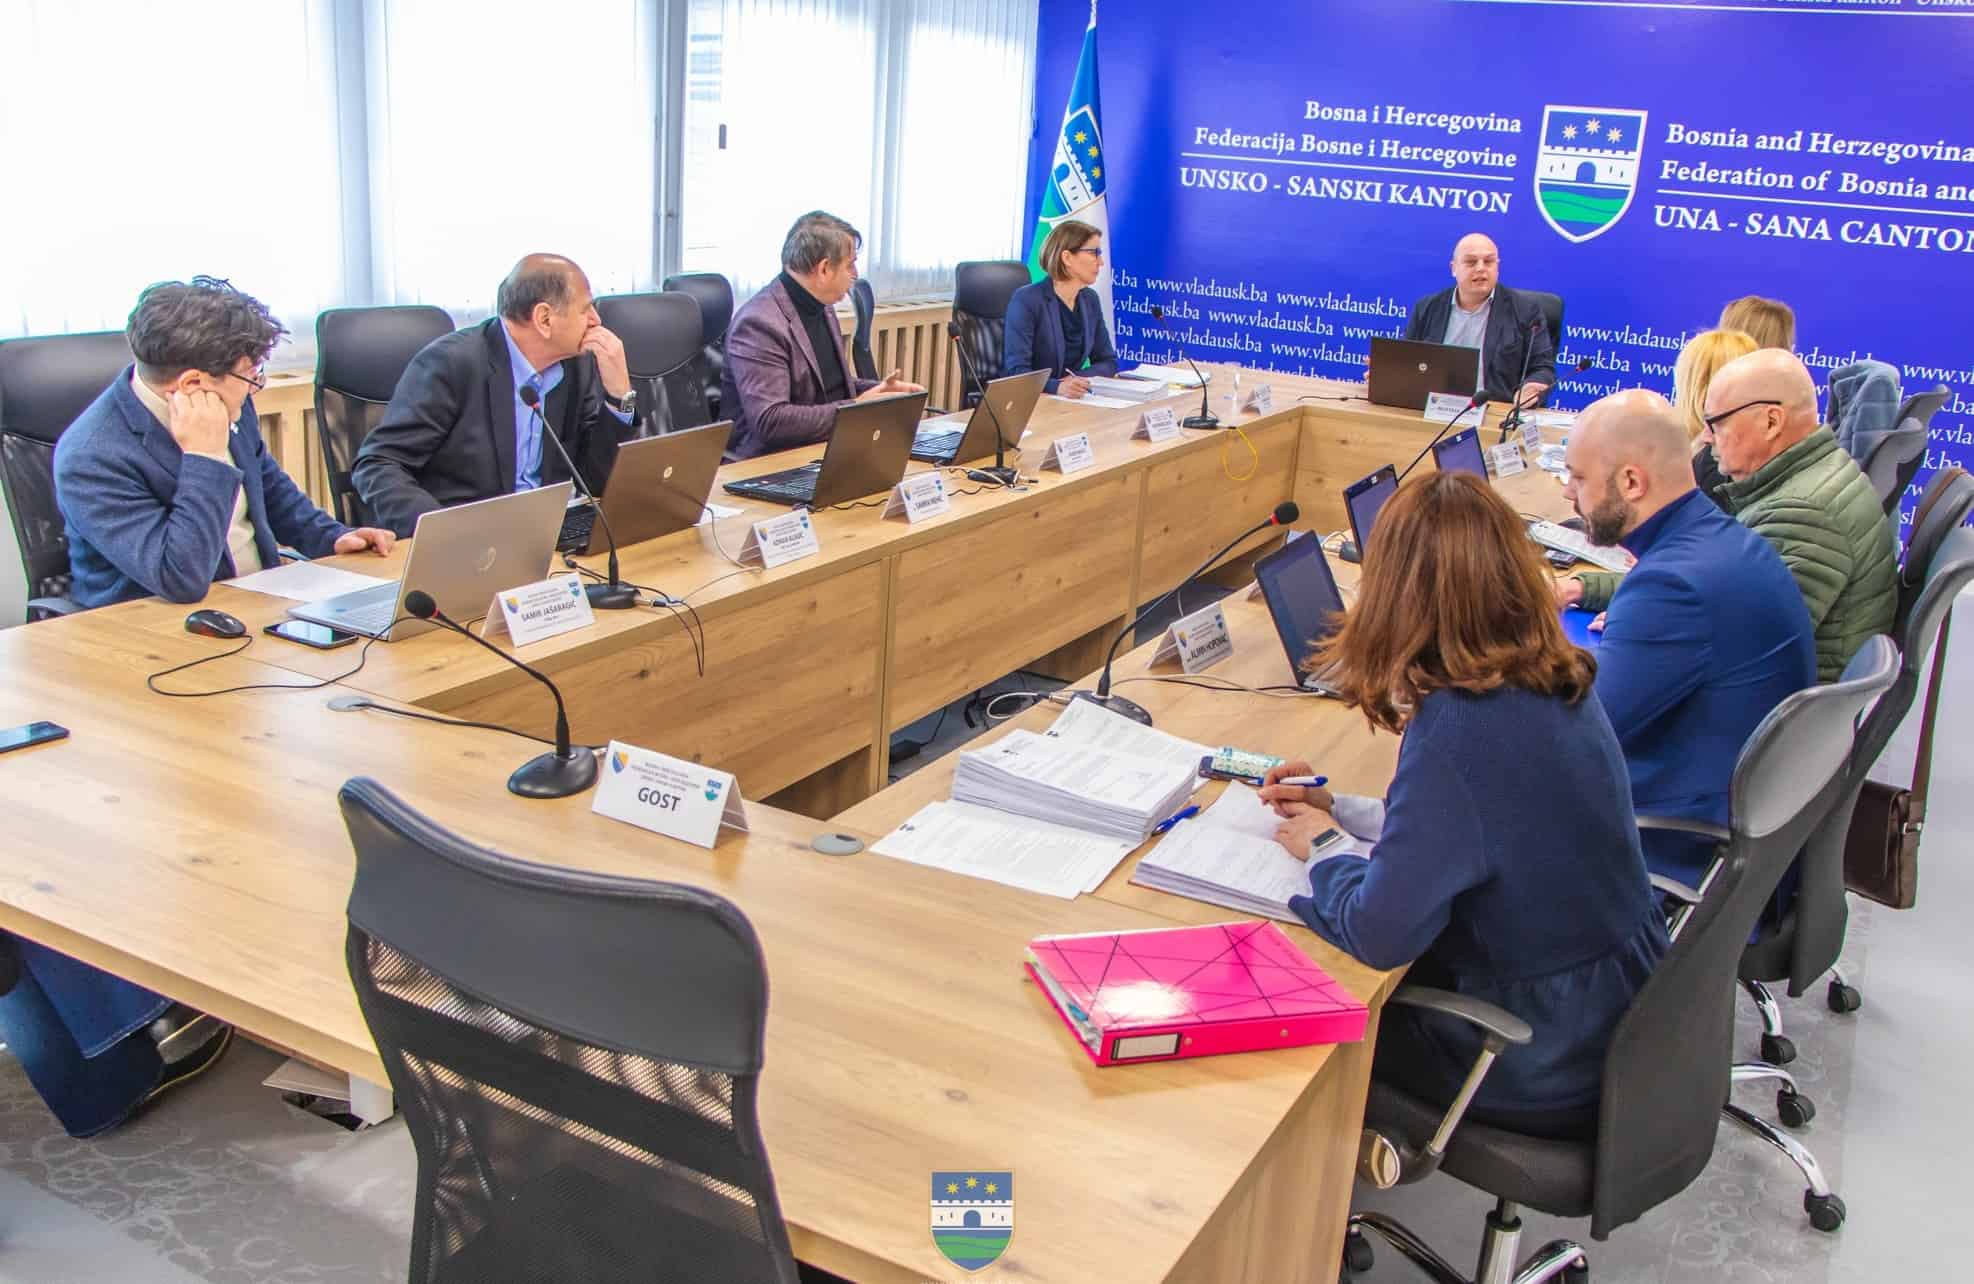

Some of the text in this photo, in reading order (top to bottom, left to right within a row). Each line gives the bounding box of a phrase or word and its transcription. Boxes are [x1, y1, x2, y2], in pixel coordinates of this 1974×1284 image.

[1304, 100, 1522, 135] Bosna i Hercegovina
[1195, 127, 1517, 169] Federacija Bosne i Hercegovine
[1665, 123, 1974, 164] Bosnia and Herzegovina
[1179, 166, 1268, 193] UNSKO
[1287, 175, 1384, 203] SANSKI
[1387, 183, 1513, 214] KANTON
[1660, 159, 1794, 189] Federation
[1800, 169, 1832, 191] of
[1837, 172, 1928, 199] Bosnia
[1654, 204, 1722, 232] UNA
[1745, 212, 1833, 241] SANA
[1146, 276, 1268, 303] www.vladausk.ba
[1276, 291, 1407, 318] www.vladausk.ba
[1142, 326, 1262, 353] www.vladausk.ba
[1208, 308, 1334, 336] www.vladausk.ba
[638, 786, 681, 812] GOST
